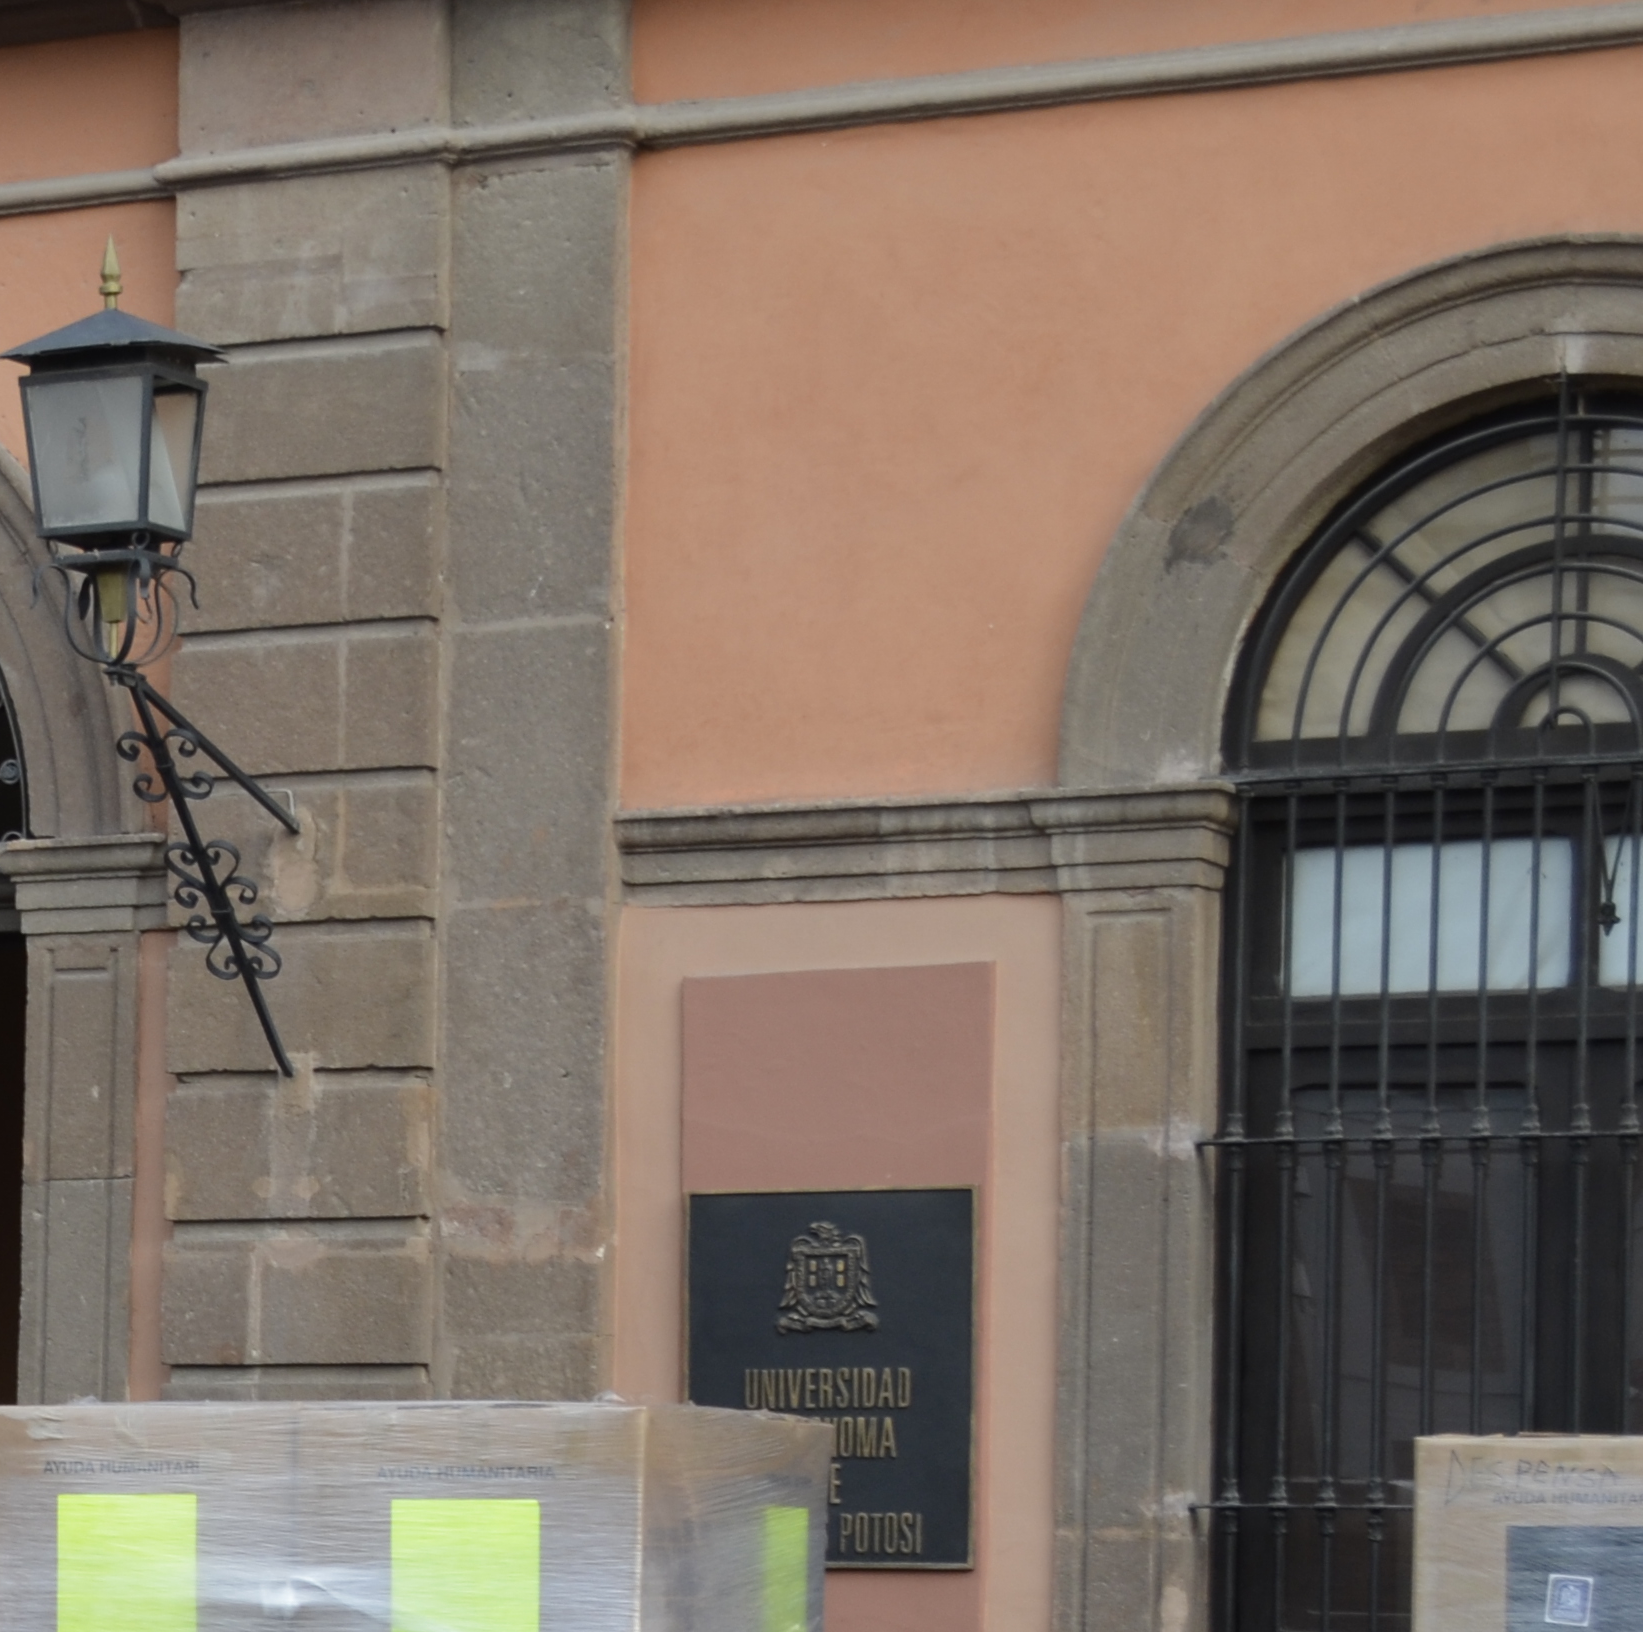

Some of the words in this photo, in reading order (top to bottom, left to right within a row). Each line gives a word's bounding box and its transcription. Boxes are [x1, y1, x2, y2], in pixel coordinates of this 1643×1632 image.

[744, 1366, 913, 1409] UNIVERSIDAD
[42, 1459, 95, 1475] AYUDA
[99, 1459, 201, 1476] HUMANITARI
[376, 1464, 432, 1481] AYUDA
[437, 1464, 557, 1482] HUMANITARIA
[1493, 1492, 1546, 1505] AYUDA
[839, 1511, 923, 1555] POTOSI
